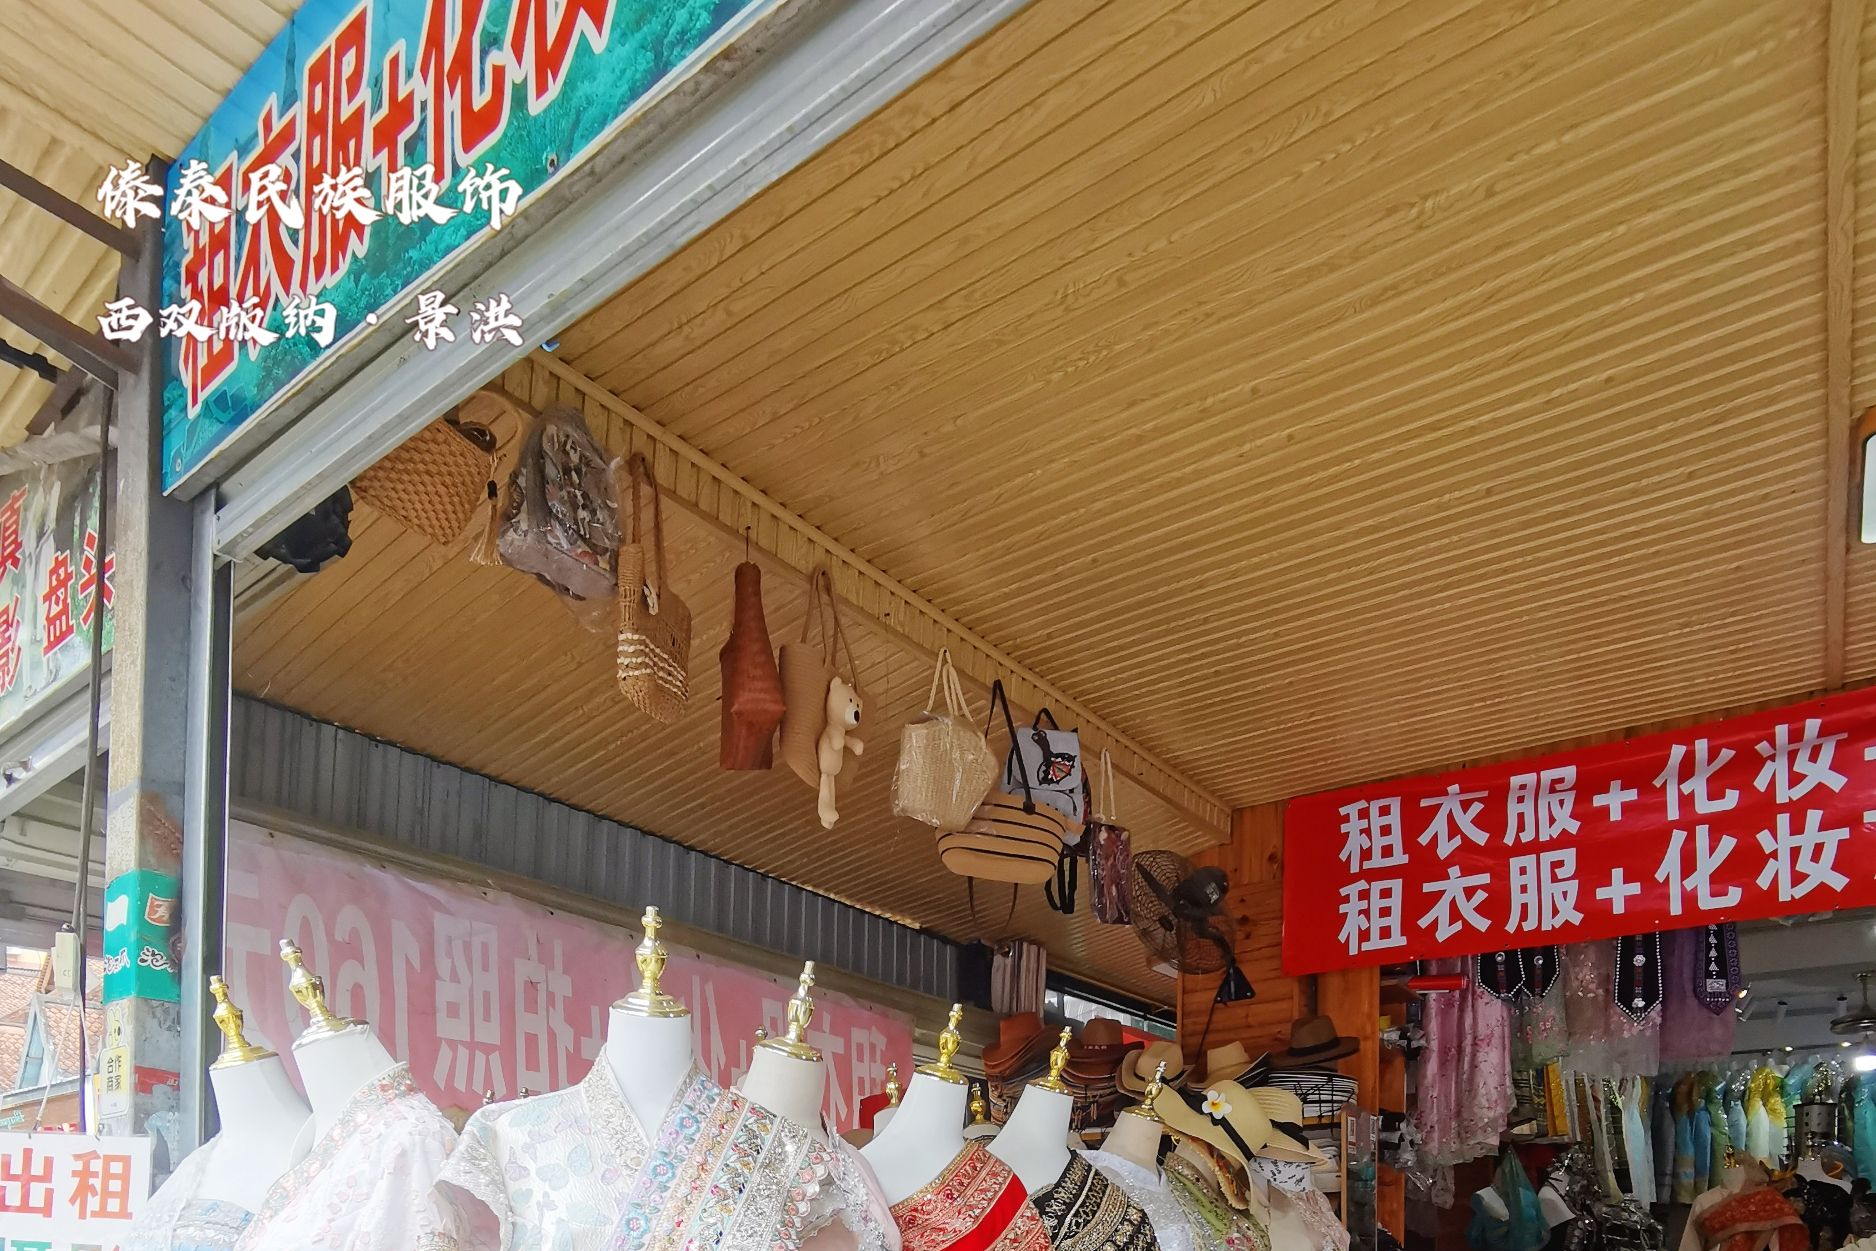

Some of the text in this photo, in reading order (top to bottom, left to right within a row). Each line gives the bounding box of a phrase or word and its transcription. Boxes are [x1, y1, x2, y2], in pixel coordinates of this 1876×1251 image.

[1337, 718, 1876, 875] 租衣服+化妆
[1337, 808, 1876, 957] 租衣服+化妆
[0, 1147, 134, 1221] 出租
